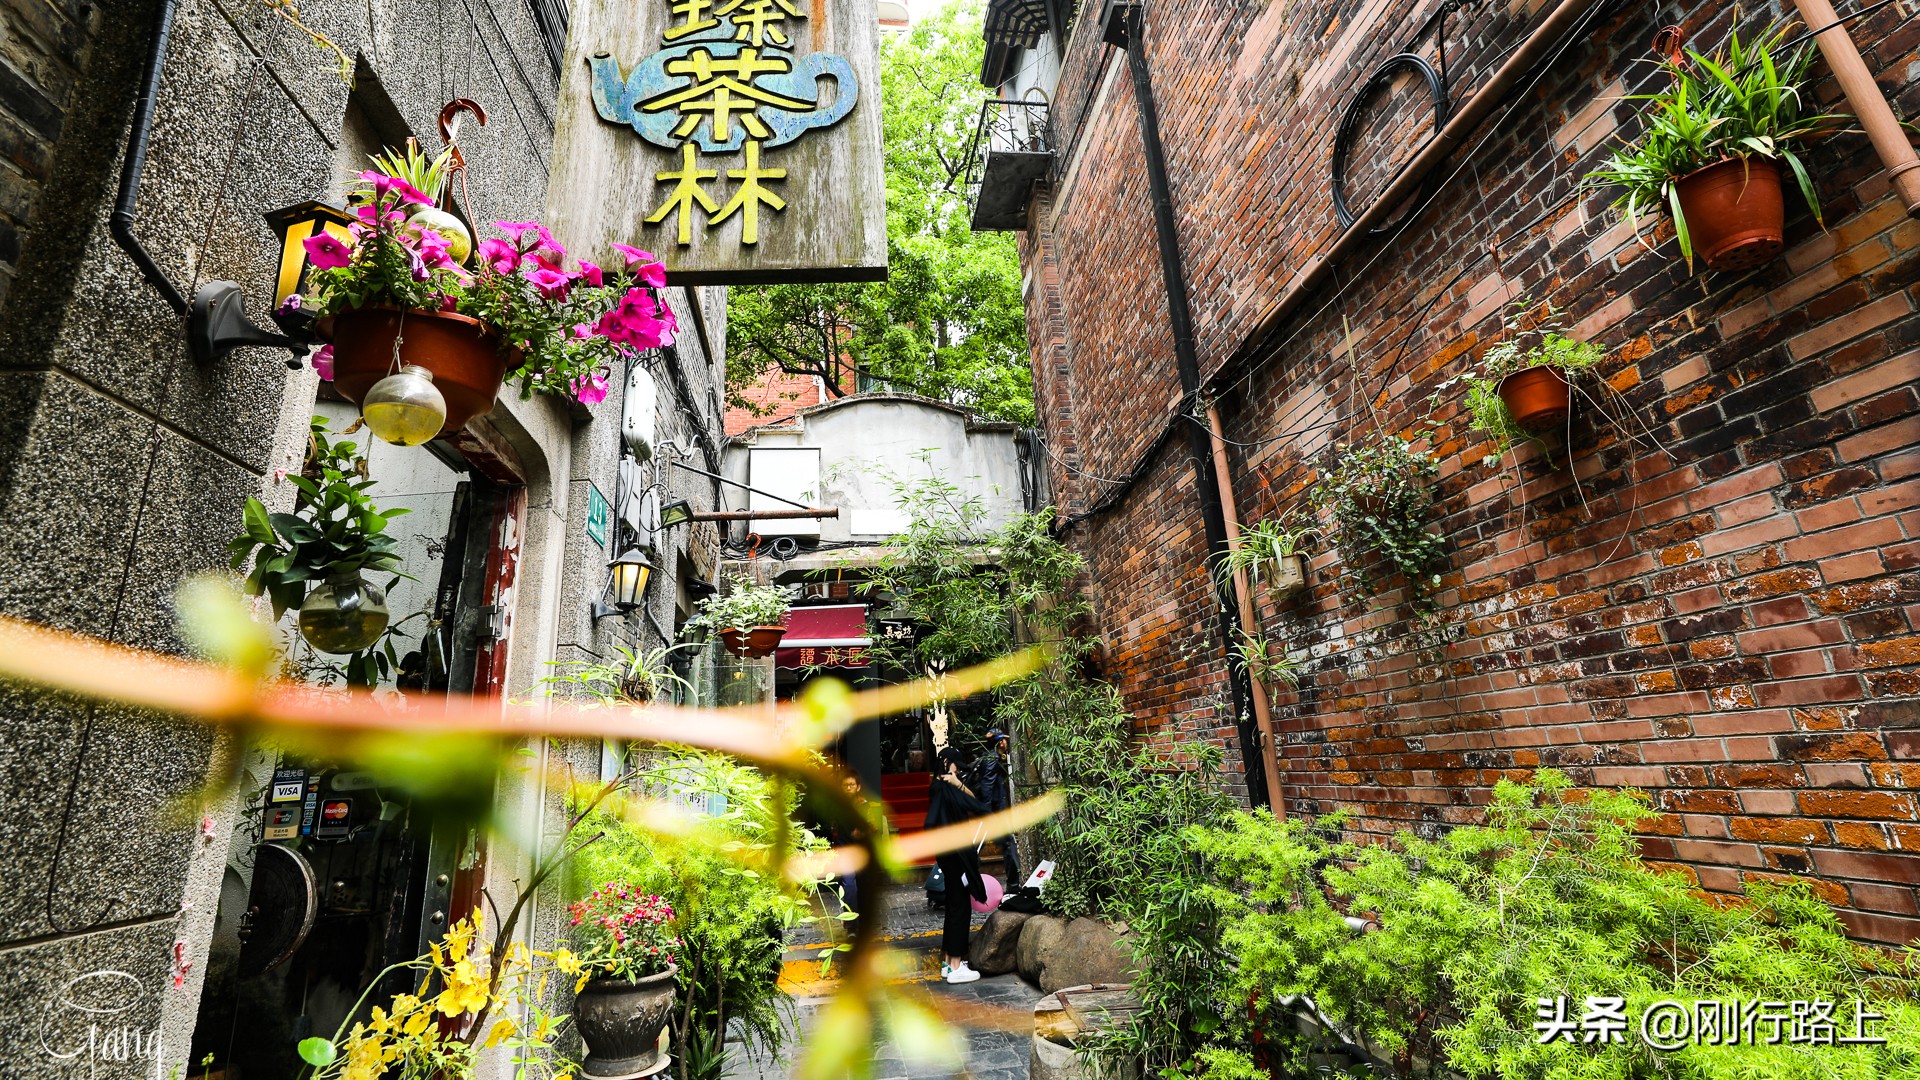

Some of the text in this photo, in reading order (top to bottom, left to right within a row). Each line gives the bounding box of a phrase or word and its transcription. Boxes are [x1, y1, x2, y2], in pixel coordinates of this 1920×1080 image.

[593, 496, 603, 526] 13
[276, 769, 304, 778] 欢迎光临
[278, 787, 298, 795] VISA
